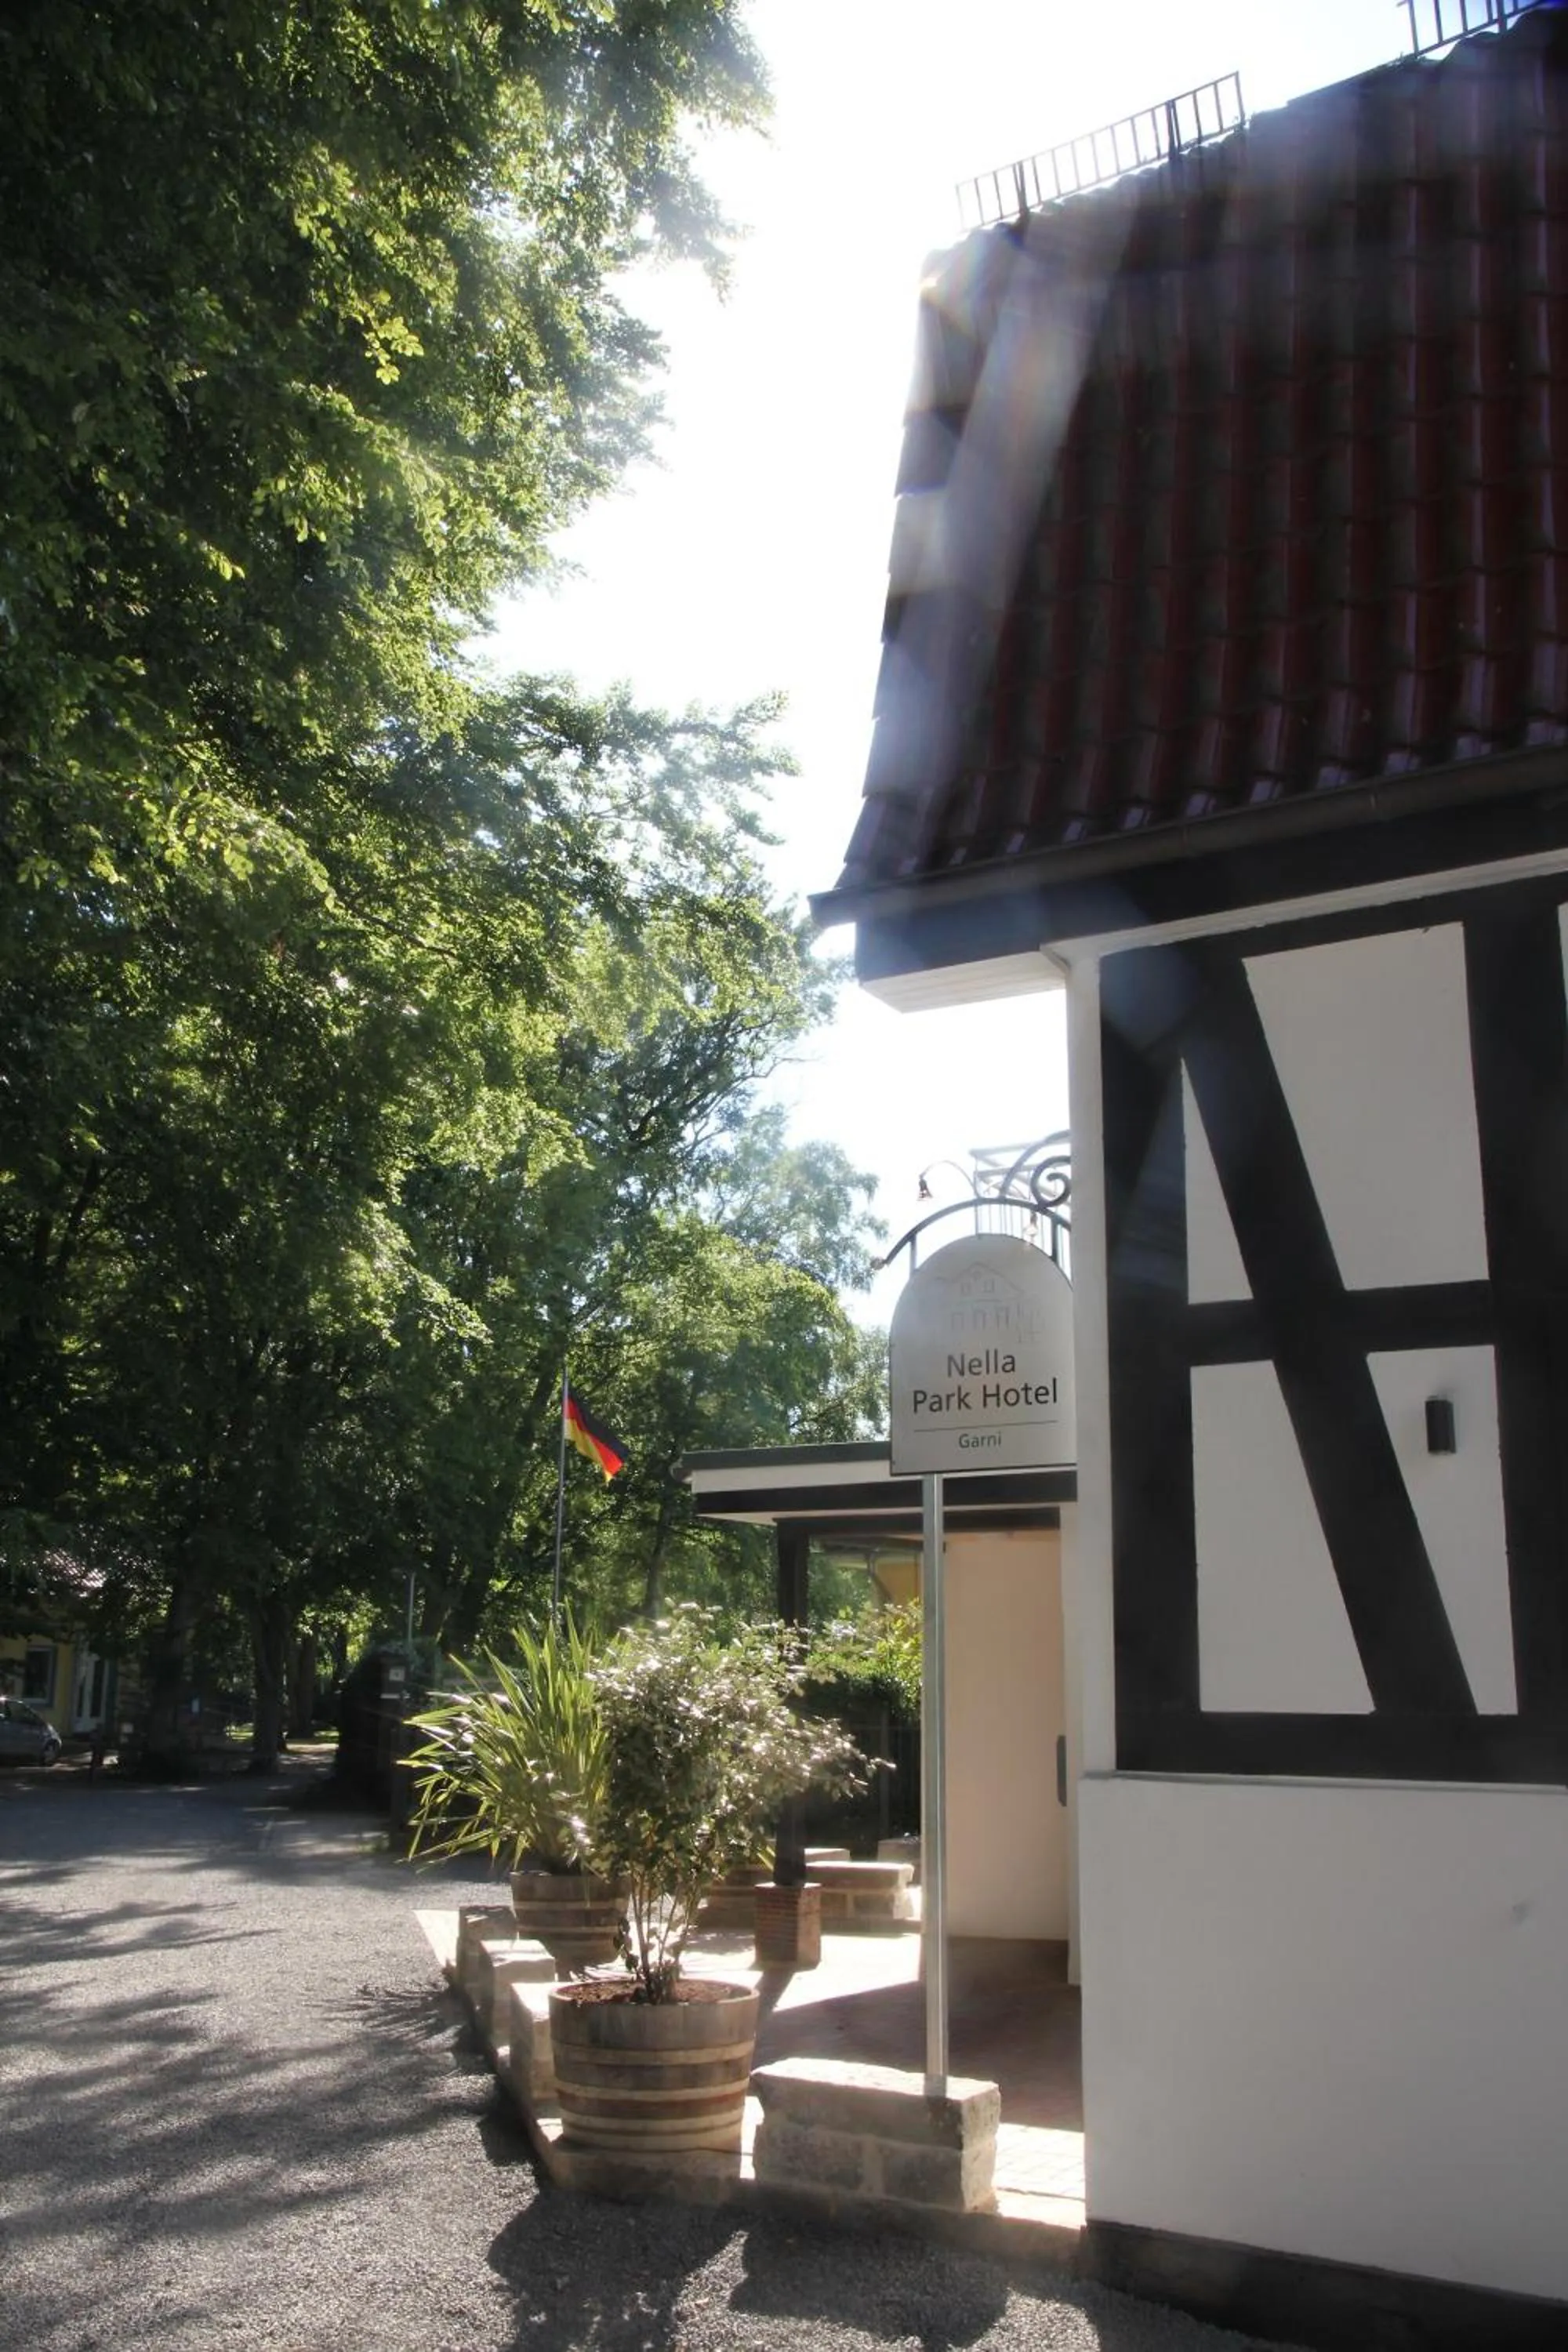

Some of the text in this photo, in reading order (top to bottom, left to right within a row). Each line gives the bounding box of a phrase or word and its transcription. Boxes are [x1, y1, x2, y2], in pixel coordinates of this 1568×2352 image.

[947, 1348, 1016, 1377] Nella
[913, 1377, 1058, 1414] Park Hotel
[958, 1432, 1002, 1449] Garni
